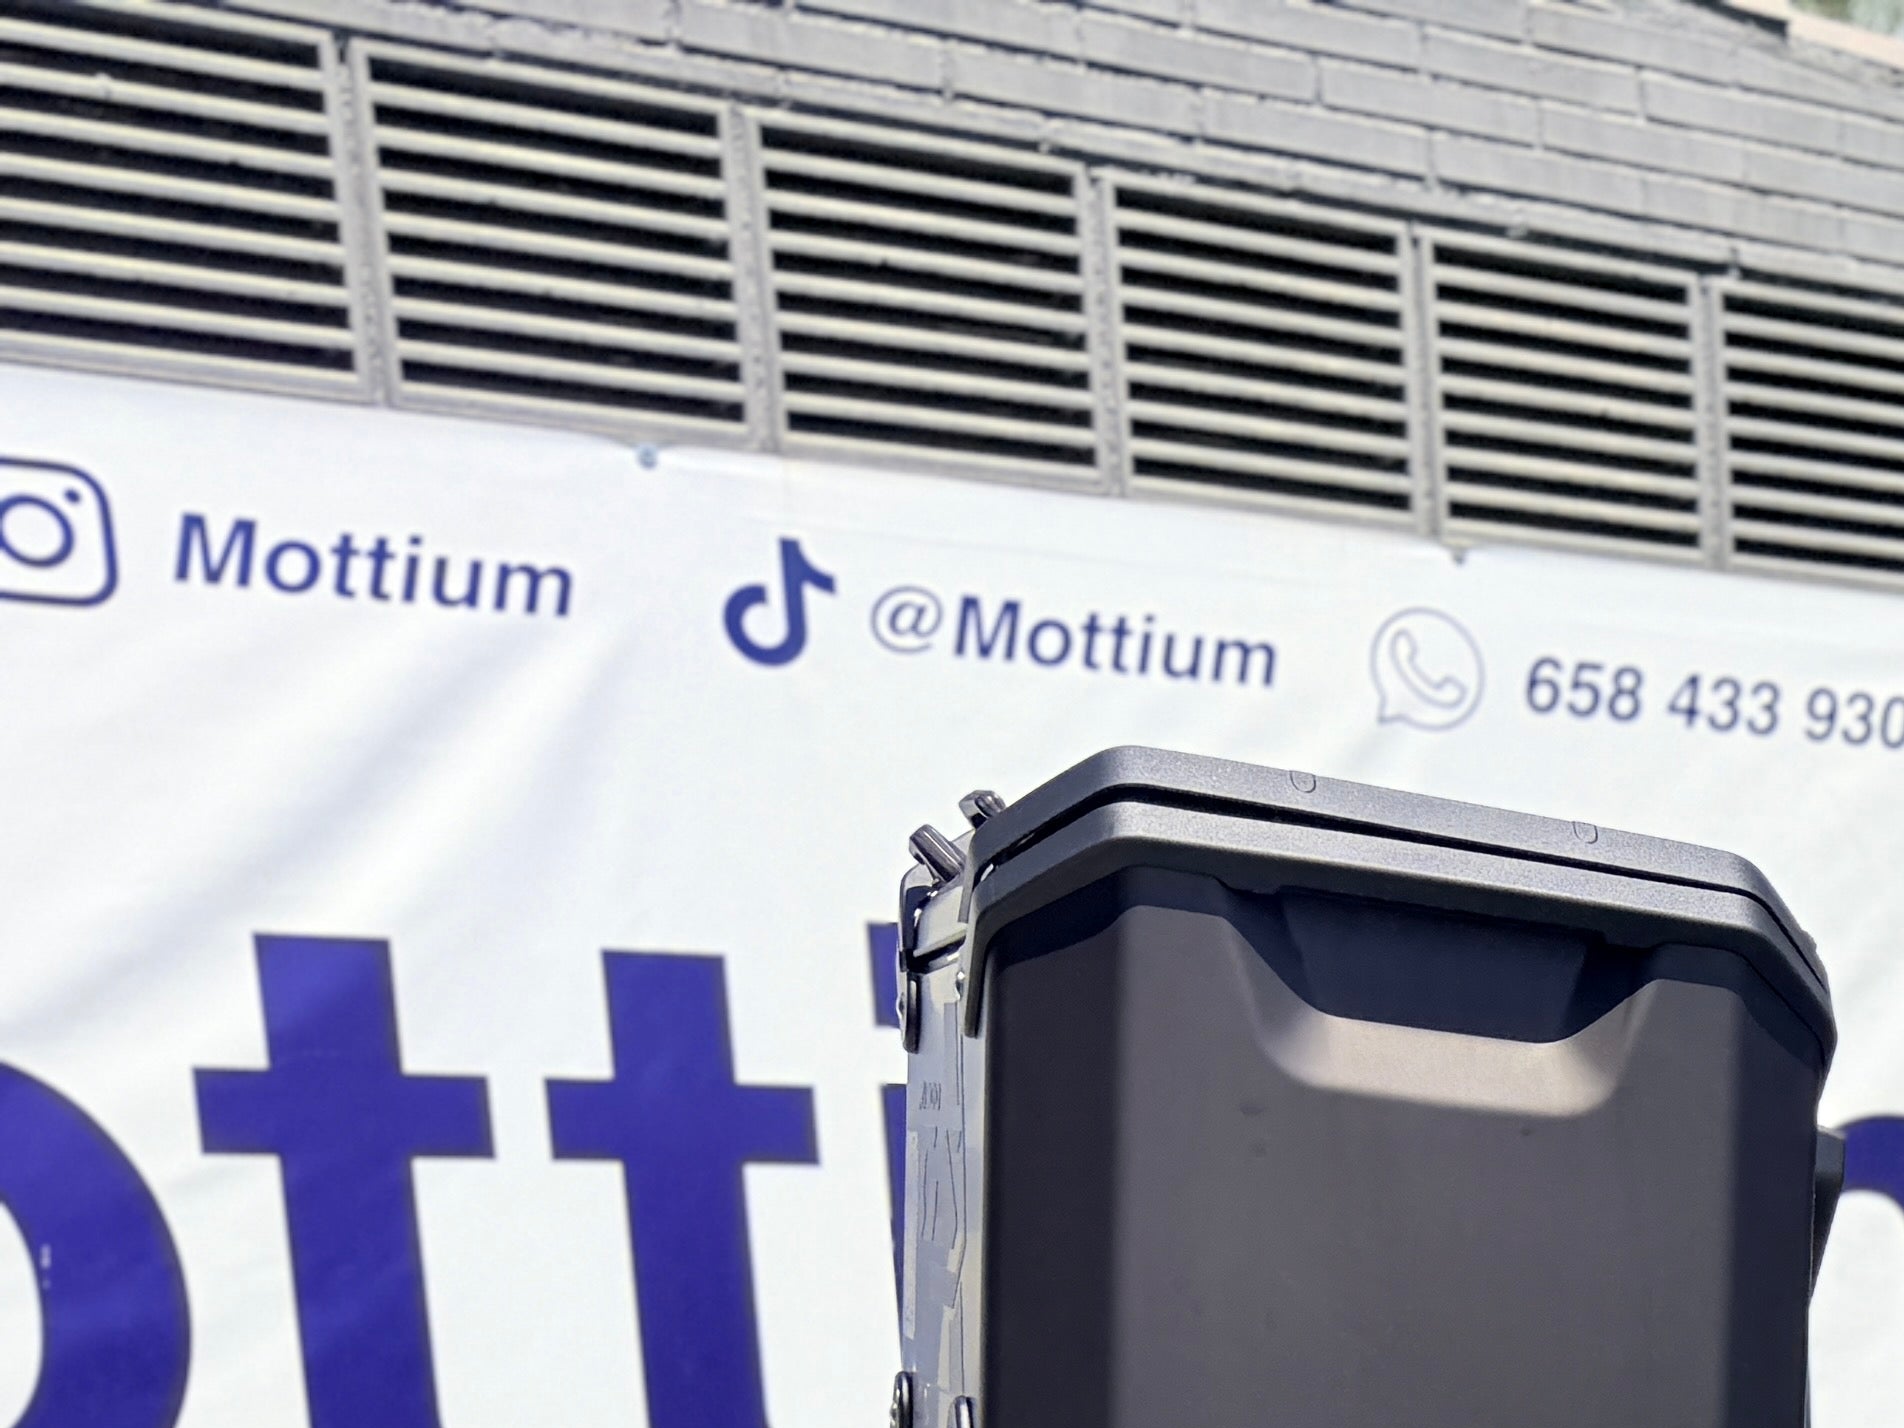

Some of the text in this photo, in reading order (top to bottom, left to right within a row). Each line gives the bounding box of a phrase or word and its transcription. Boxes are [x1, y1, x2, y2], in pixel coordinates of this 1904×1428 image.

[173, 512, 574, 618] Mottium
[869, 586, 1278, 689] @Mottium
[1524, 654, 1644, 724] 658
[1667, 671, 1780, 738] 433
